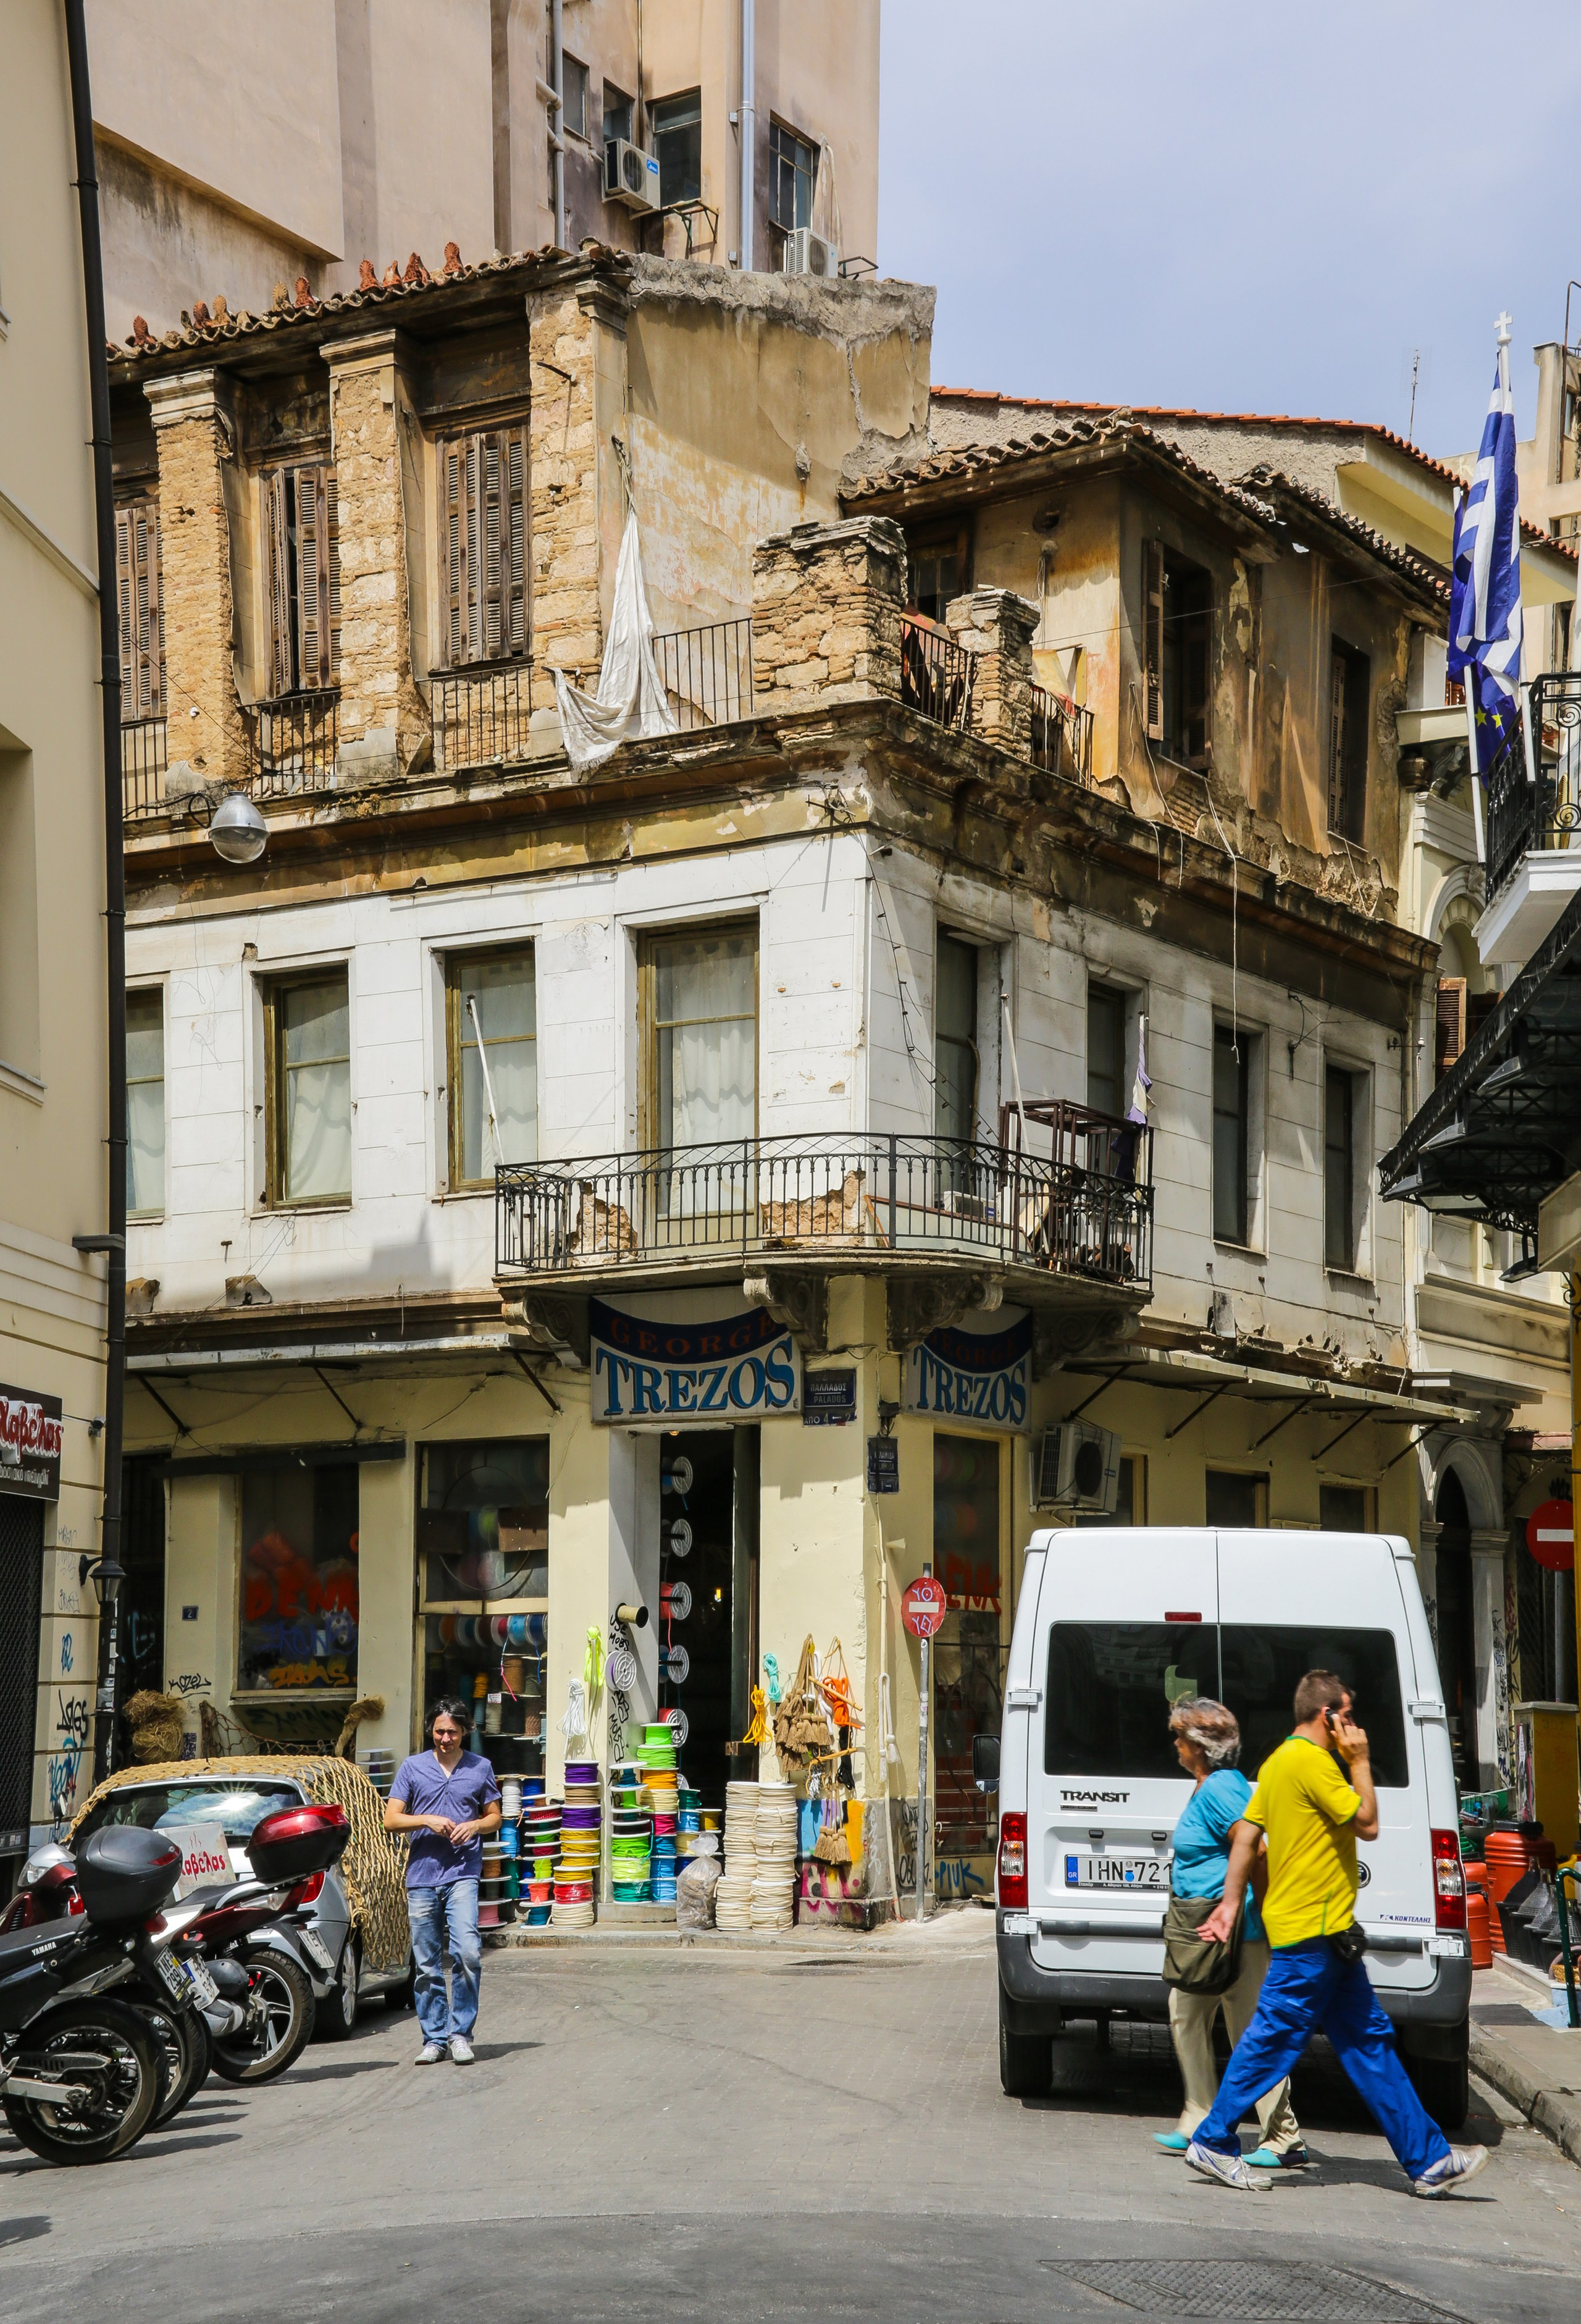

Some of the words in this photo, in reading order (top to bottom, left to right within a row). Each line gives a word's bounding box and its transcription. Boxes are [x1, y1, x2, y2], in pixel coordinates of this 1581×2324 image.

[611, 1311, 776, 1356] GEORGE
[596, 1336, 794, 1415] TREZOS
[811, 1383, 847, 1391] ΠΑΛΛΑΔΟΣ
[913, 1344, 1026, 1425] TREZOS
[814, 1395, 846, 1403] PALADOS
[912, 1588, 933, 1602] YO
[187, 1609, 192, 1618] 2
[1060, 1790, 1130, 1803] TRANSIT
[182, 1851, 225, 1881] αβέλας
[1394, 1915, 1432, 1923] ΚΟΝΤΕΛΛΗΣ
[31, 1942, 57, 1956] YAMAHA
